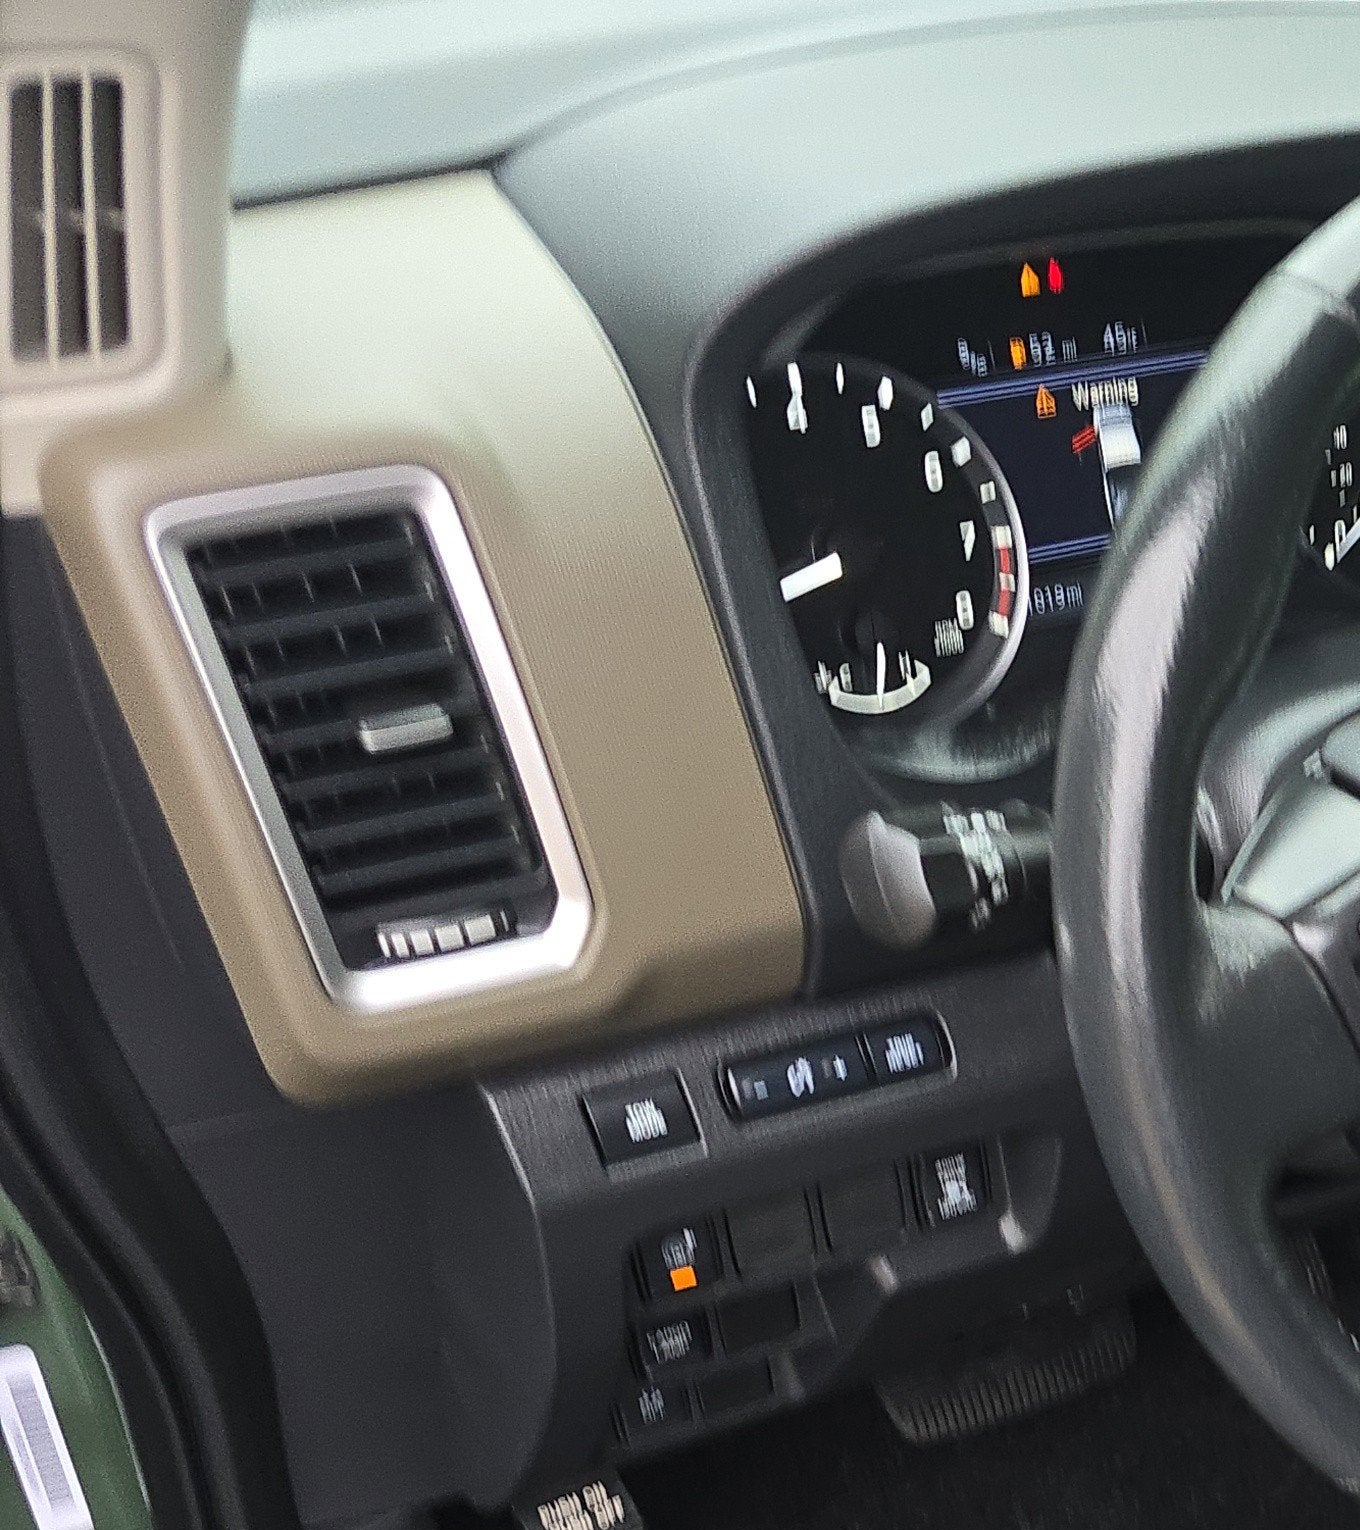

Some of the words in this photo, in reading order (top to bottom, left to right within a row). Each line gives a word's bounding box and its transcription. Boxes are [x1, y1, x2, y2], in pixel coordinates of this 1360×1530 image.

[1071, 376, 1139, 411] Warning
[861, 403, 881, 448] 5
[924, 450, 943, 492] 6
[960, 520, 975, 561] 7
[955, 590, 972, 630] 8
